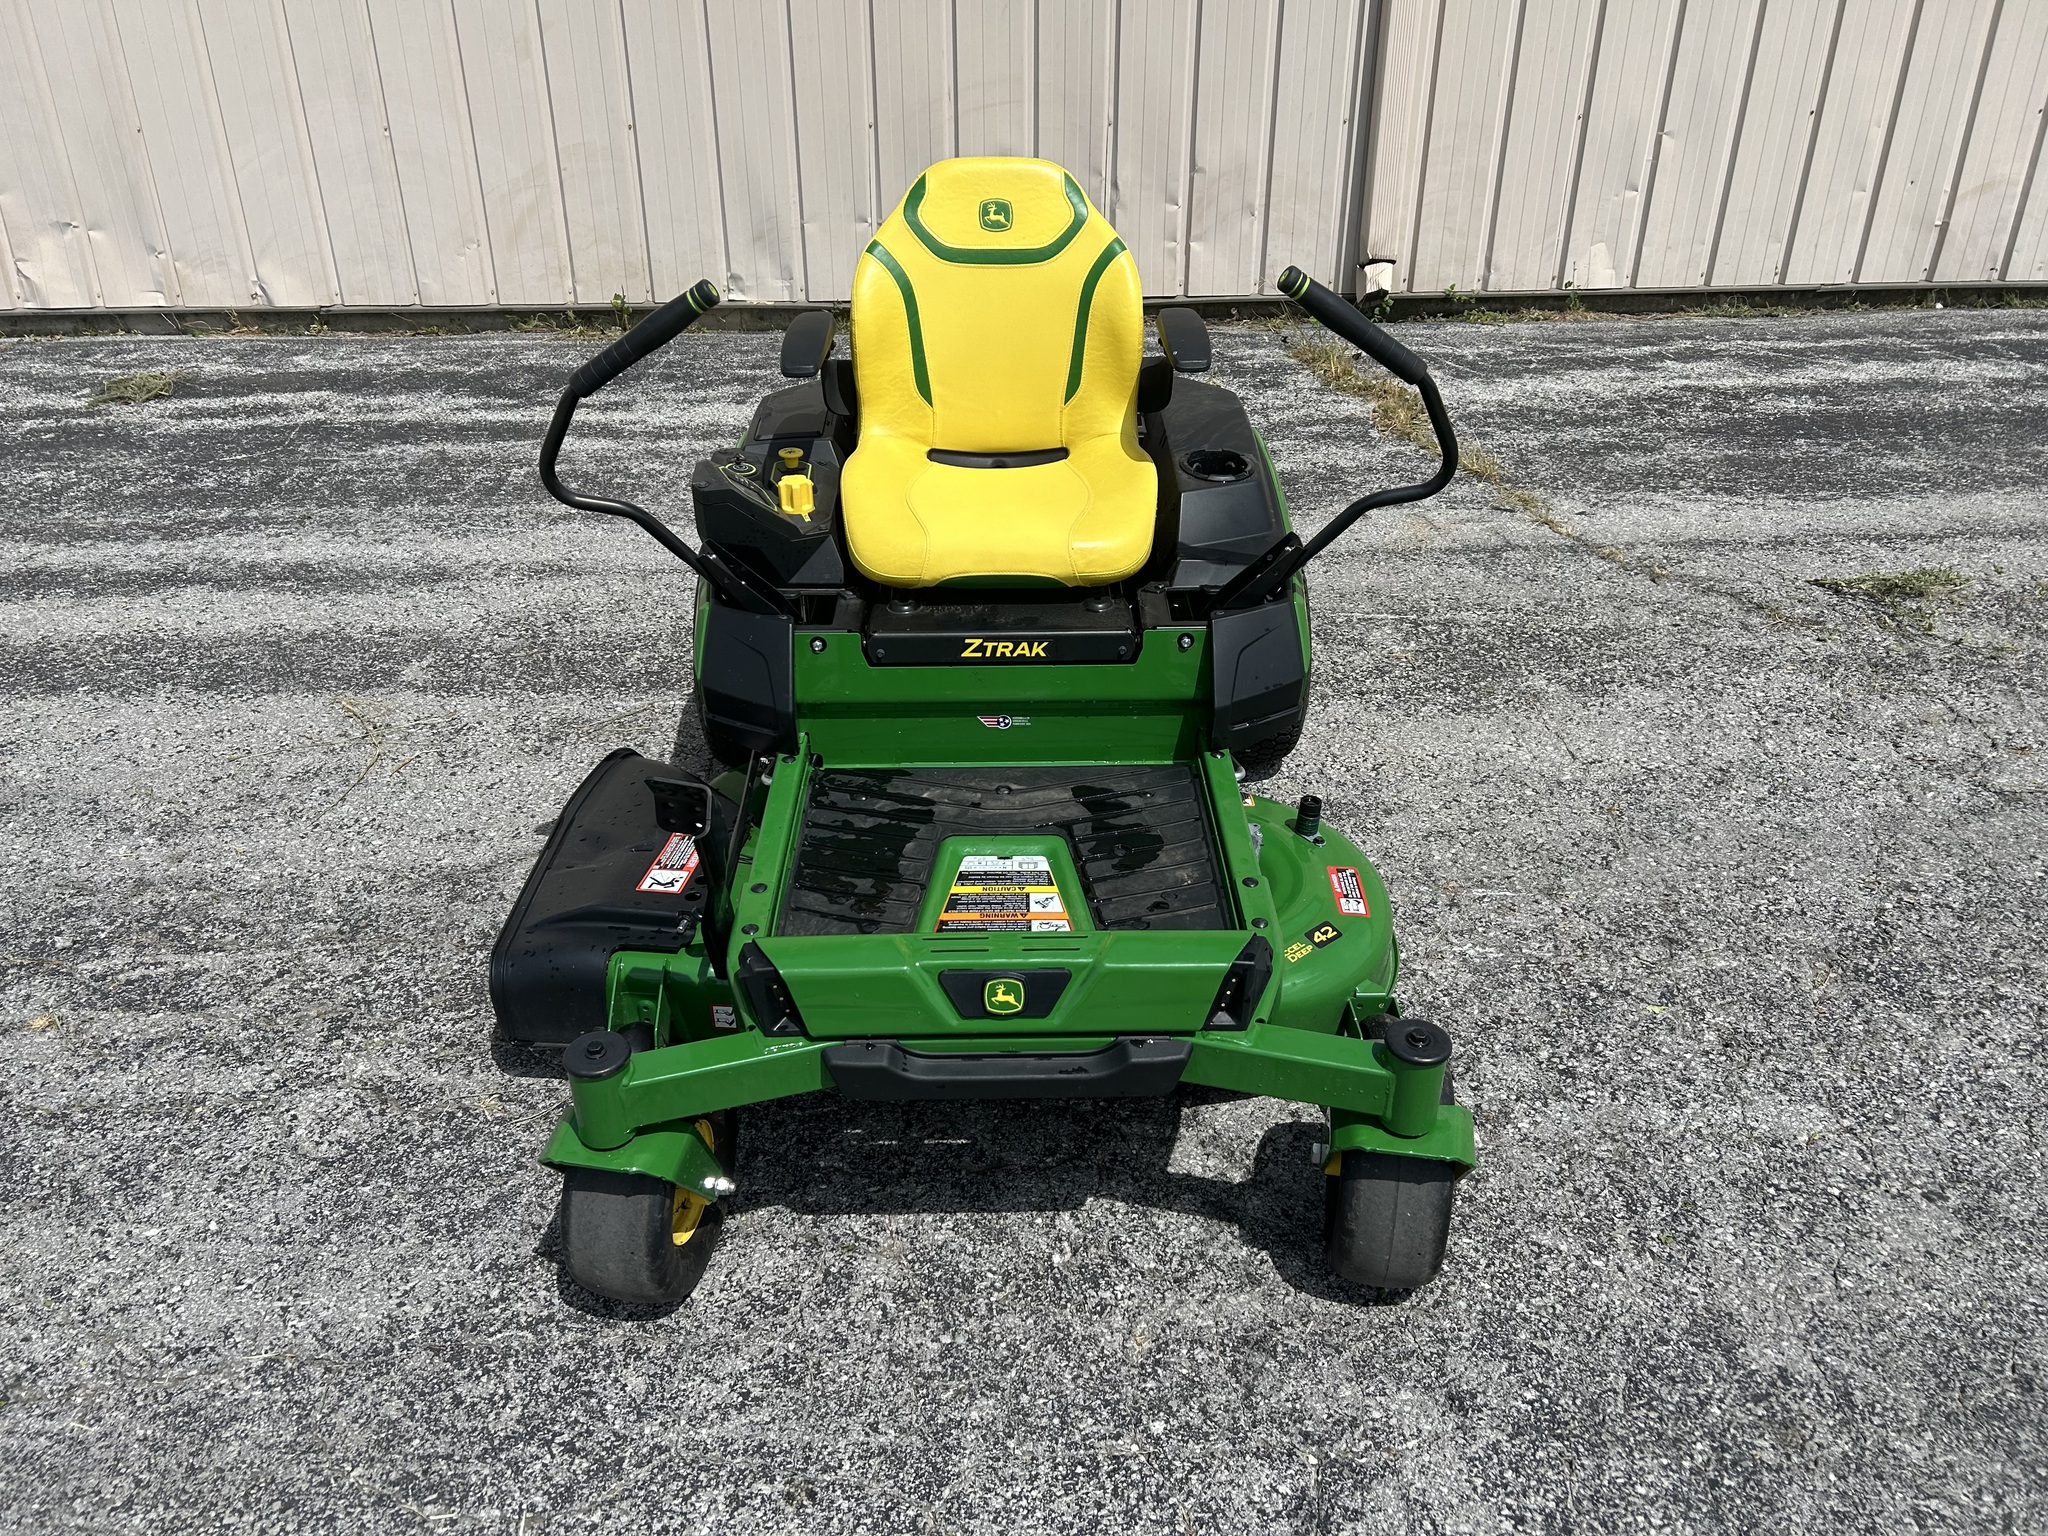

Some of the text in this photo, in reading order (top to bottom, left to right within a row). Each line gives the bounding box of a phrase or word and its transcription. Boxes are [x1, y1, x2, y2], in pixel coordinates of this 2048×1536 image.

[960, 638, 1050, 657] ZTRAK
[1313, 926, 1337, 943] 42
[1287, 945, 1313, 962] DEEP
